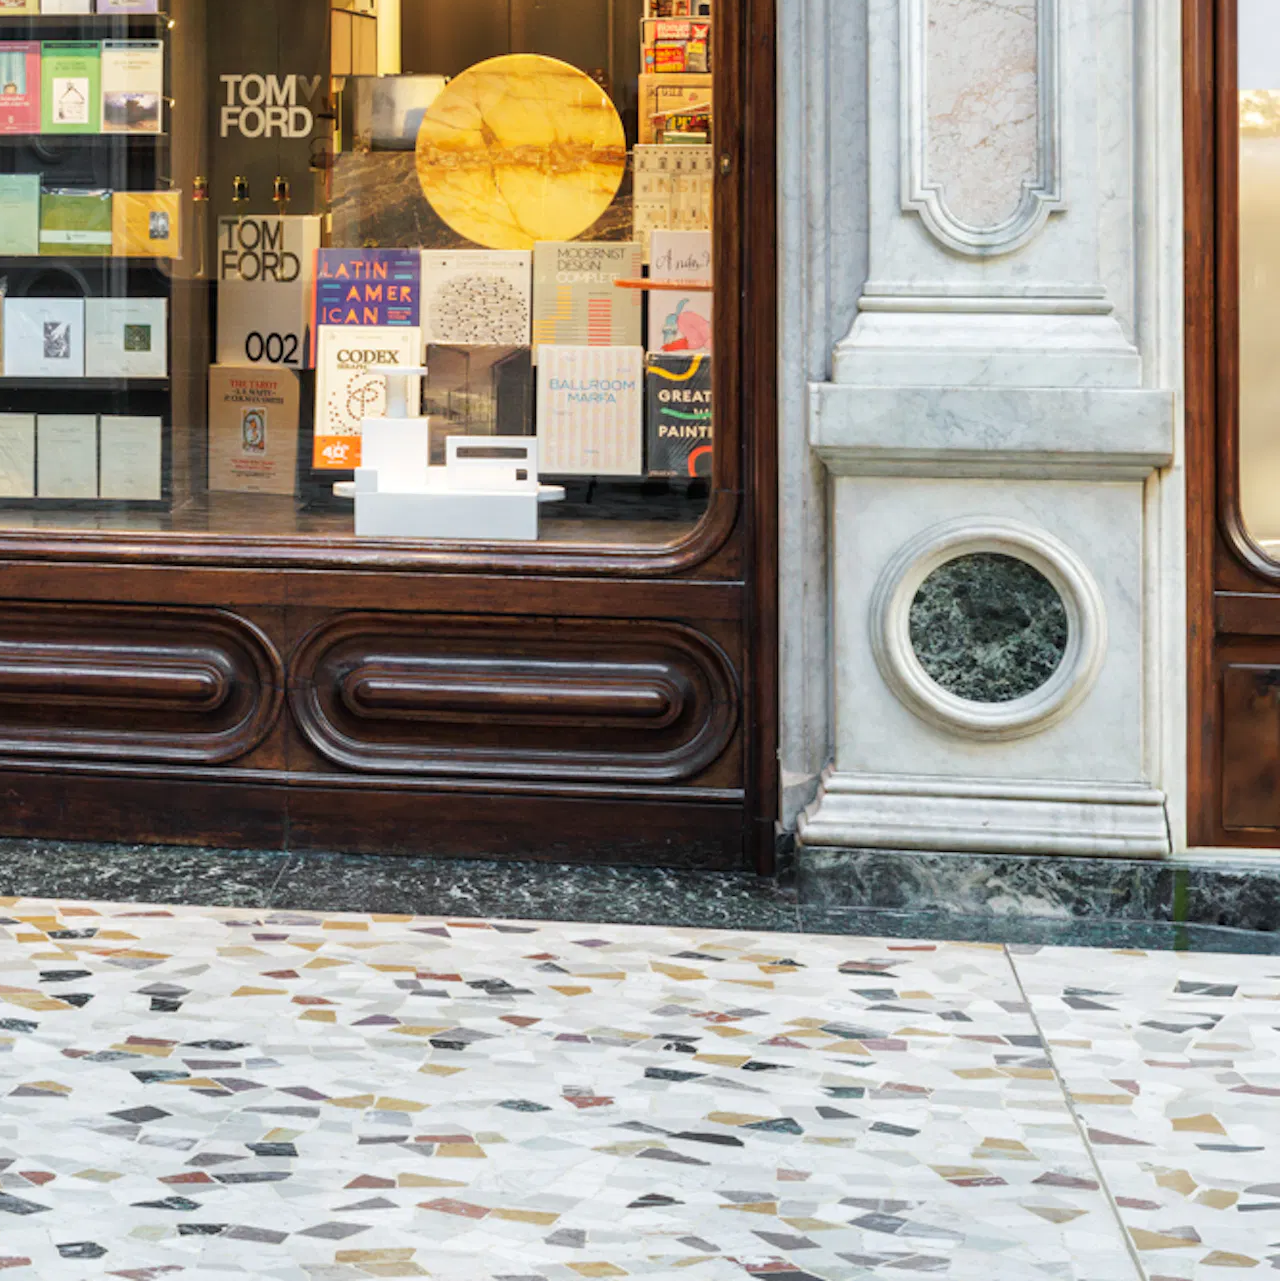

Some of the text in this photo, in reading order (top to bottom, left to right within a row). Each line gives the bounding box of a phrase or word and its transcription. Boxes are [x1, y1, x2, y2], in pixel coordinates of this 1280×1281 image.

[219, 73, 297, 107] TOM
[220, 106, 314, 138] FORD
[220, 219, 284, 250] TOM
[557, 247, 626, 260] MODERNIST
[221, 250, 301, 282] FORD
[322, 260, 389, 280] LATIN
[557, 259, 602, 272] DESIGN
[345, 283, 413, 303] AMER
[321, 305, 379, 326] ICAN
[245, 330, 299, 364] 002
[336, 348, 400, 365] CODEX
[548, 377, 636, 392] BALLROOM
[567, 391, 617, 404] MARFA
[658, 388, 713, 403] GREAT
